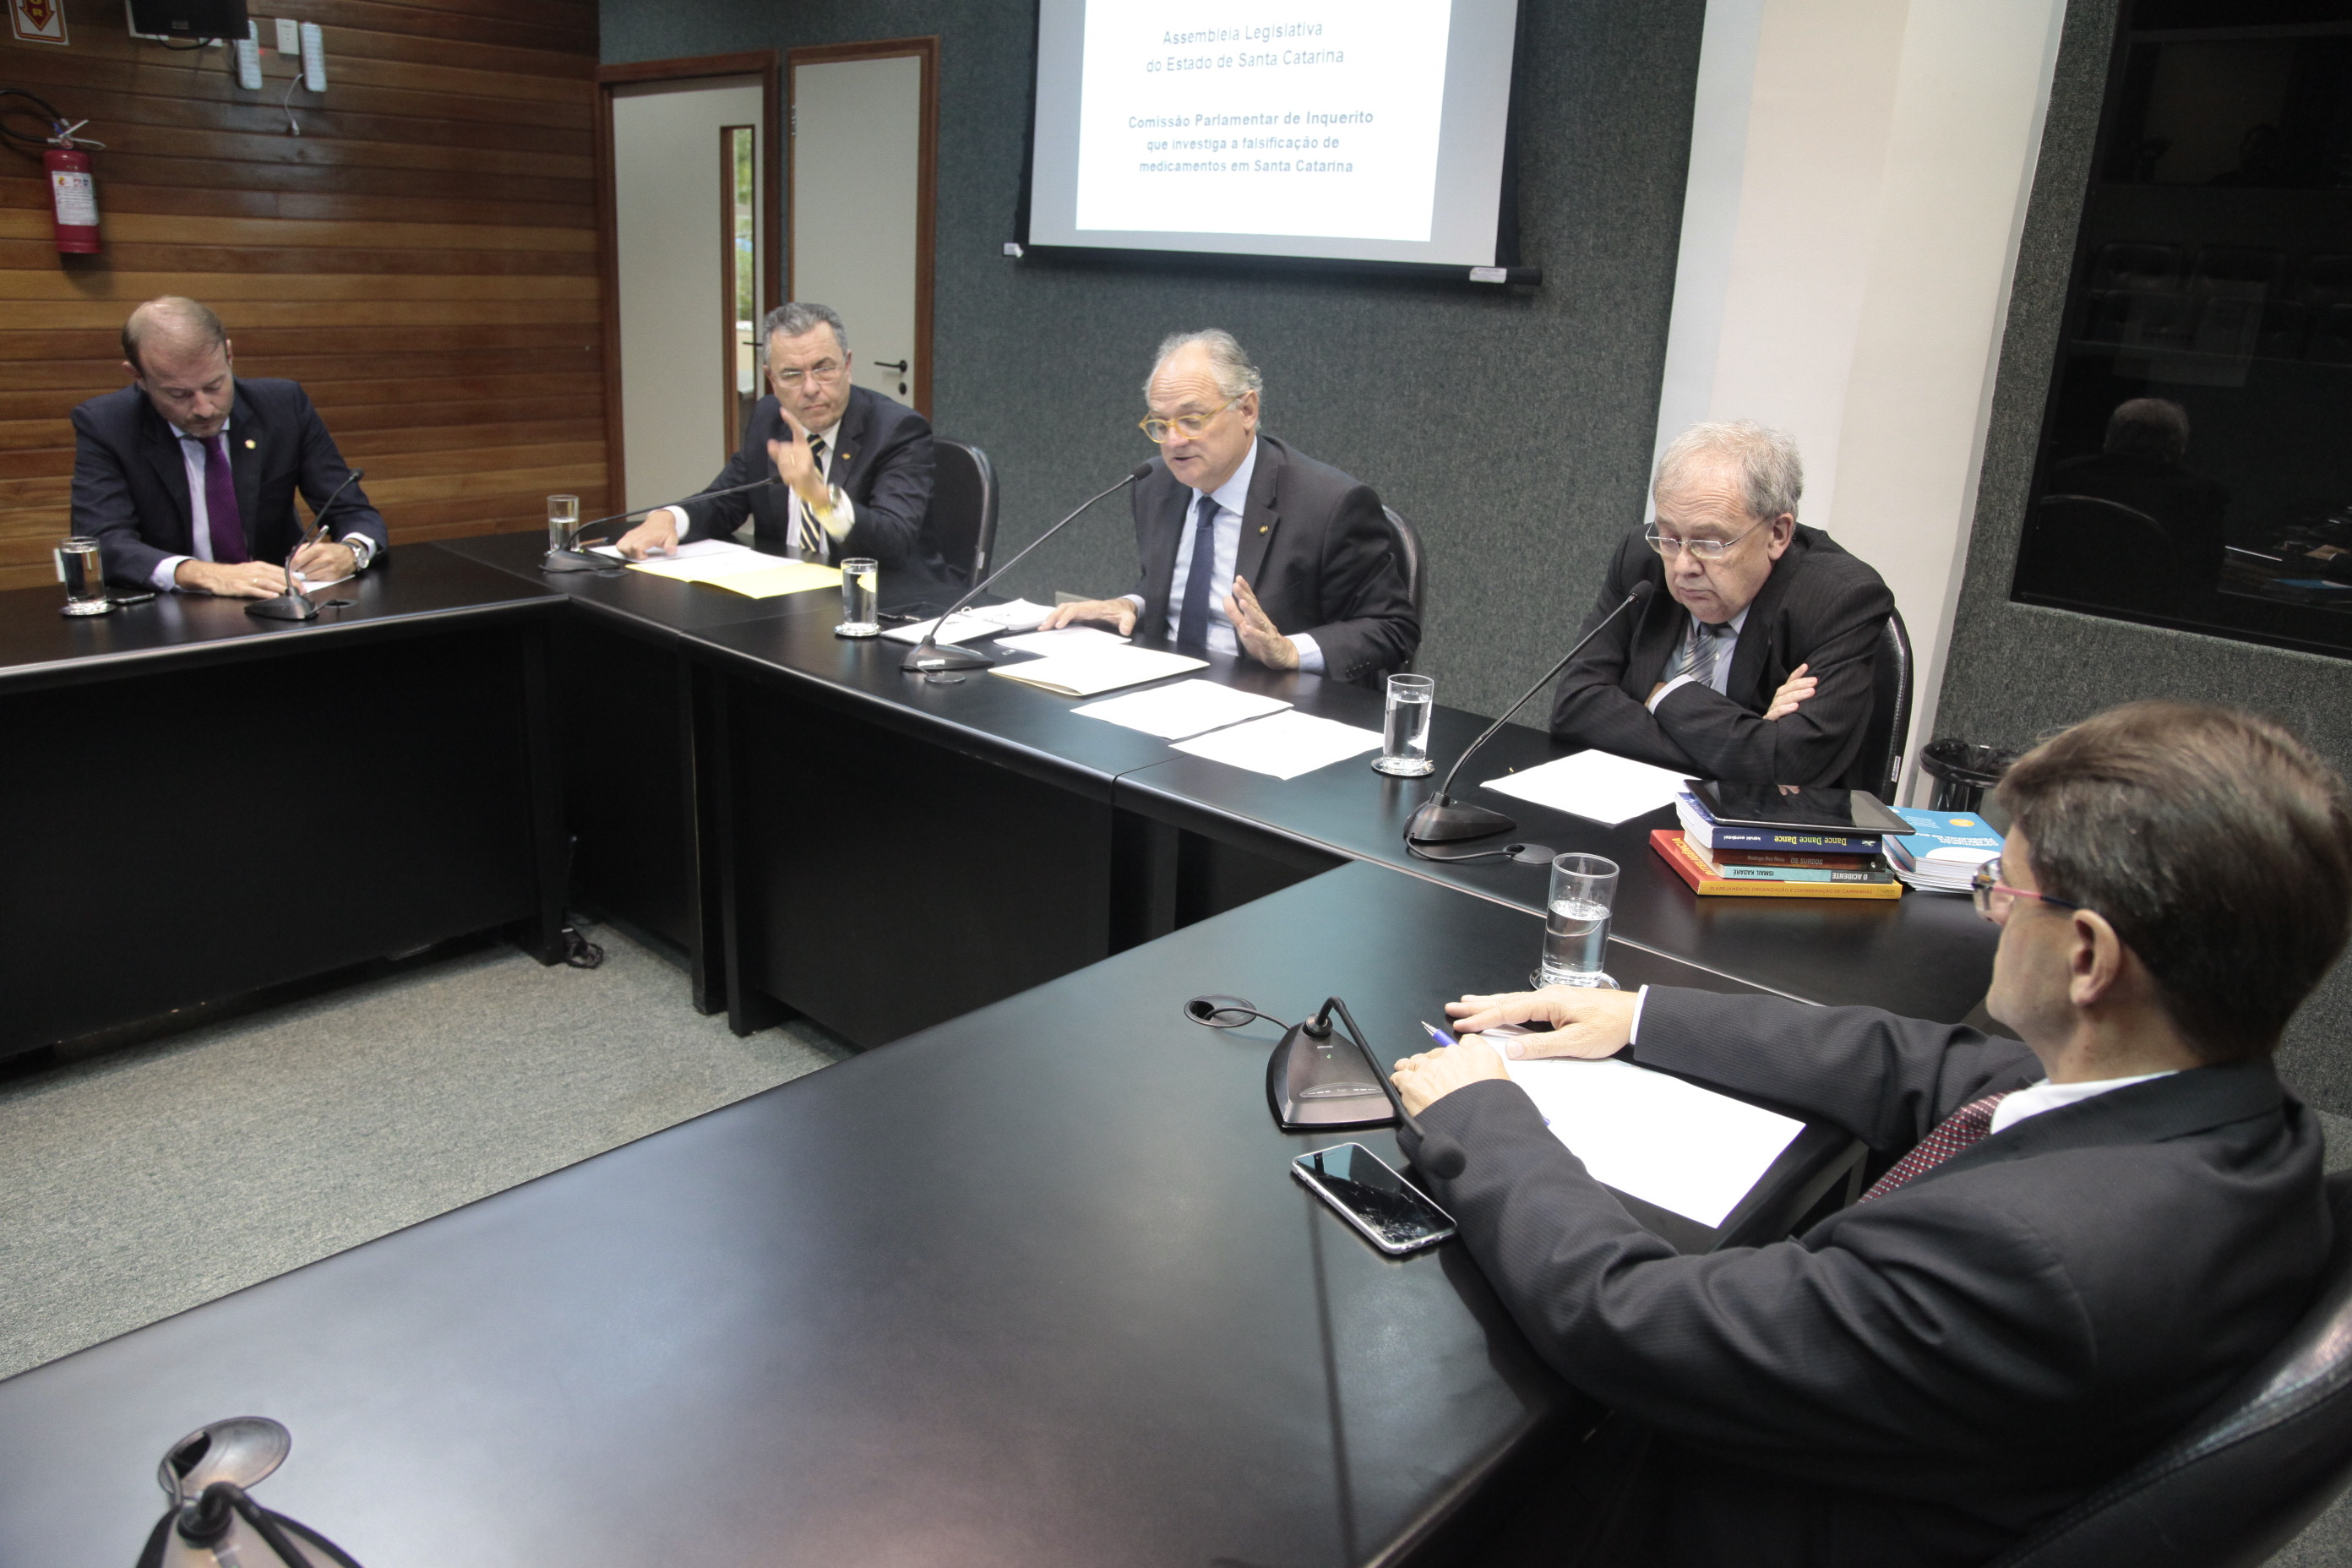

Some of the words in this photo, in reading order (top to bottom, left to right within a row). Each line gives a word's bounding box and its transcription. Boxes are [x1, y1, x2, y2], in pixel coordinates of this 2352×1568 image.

[1163, 27, 1240, 45] Assembleia
[1246, 22, 1323, 42] Legislativa
[1146, 59, 1162, 73] do
[1168, 55, 1212, 71] Estado
[1217, 53, 1233, 68] de
[1239, 52, 1277, 68] Santa
[1283, 48, 1344, 65] Catarina
[1129, 115, 1190, 128] Comissão
[1195, 113, 1280, 127] Parlamentar
[1284, 112, 1301, 125] de
[1307, 111, 1374, 127] Inquerito
[1147, 140, 1168, 153] que
[1173, 138, 1228, 152] investiga
[1232, 139, 1239, 149] a
[1243, 136, 1319, 150] falsificação
[1323, 136, 1340, 149] de
[1140, 161, 1227, 172] medicamentos
[1231, 161, 1250, 172] em
[1255, 160, 1292, 172] Santa
[1296, 159, 1353, 172] Catarina
[1774, 836, 1798, 844] Dance
[1799, 836, 1822, 845] Dance
[1825, 837, 1848, 846] Dance
[1832, 872, 1863, 880] ACIDENTE
